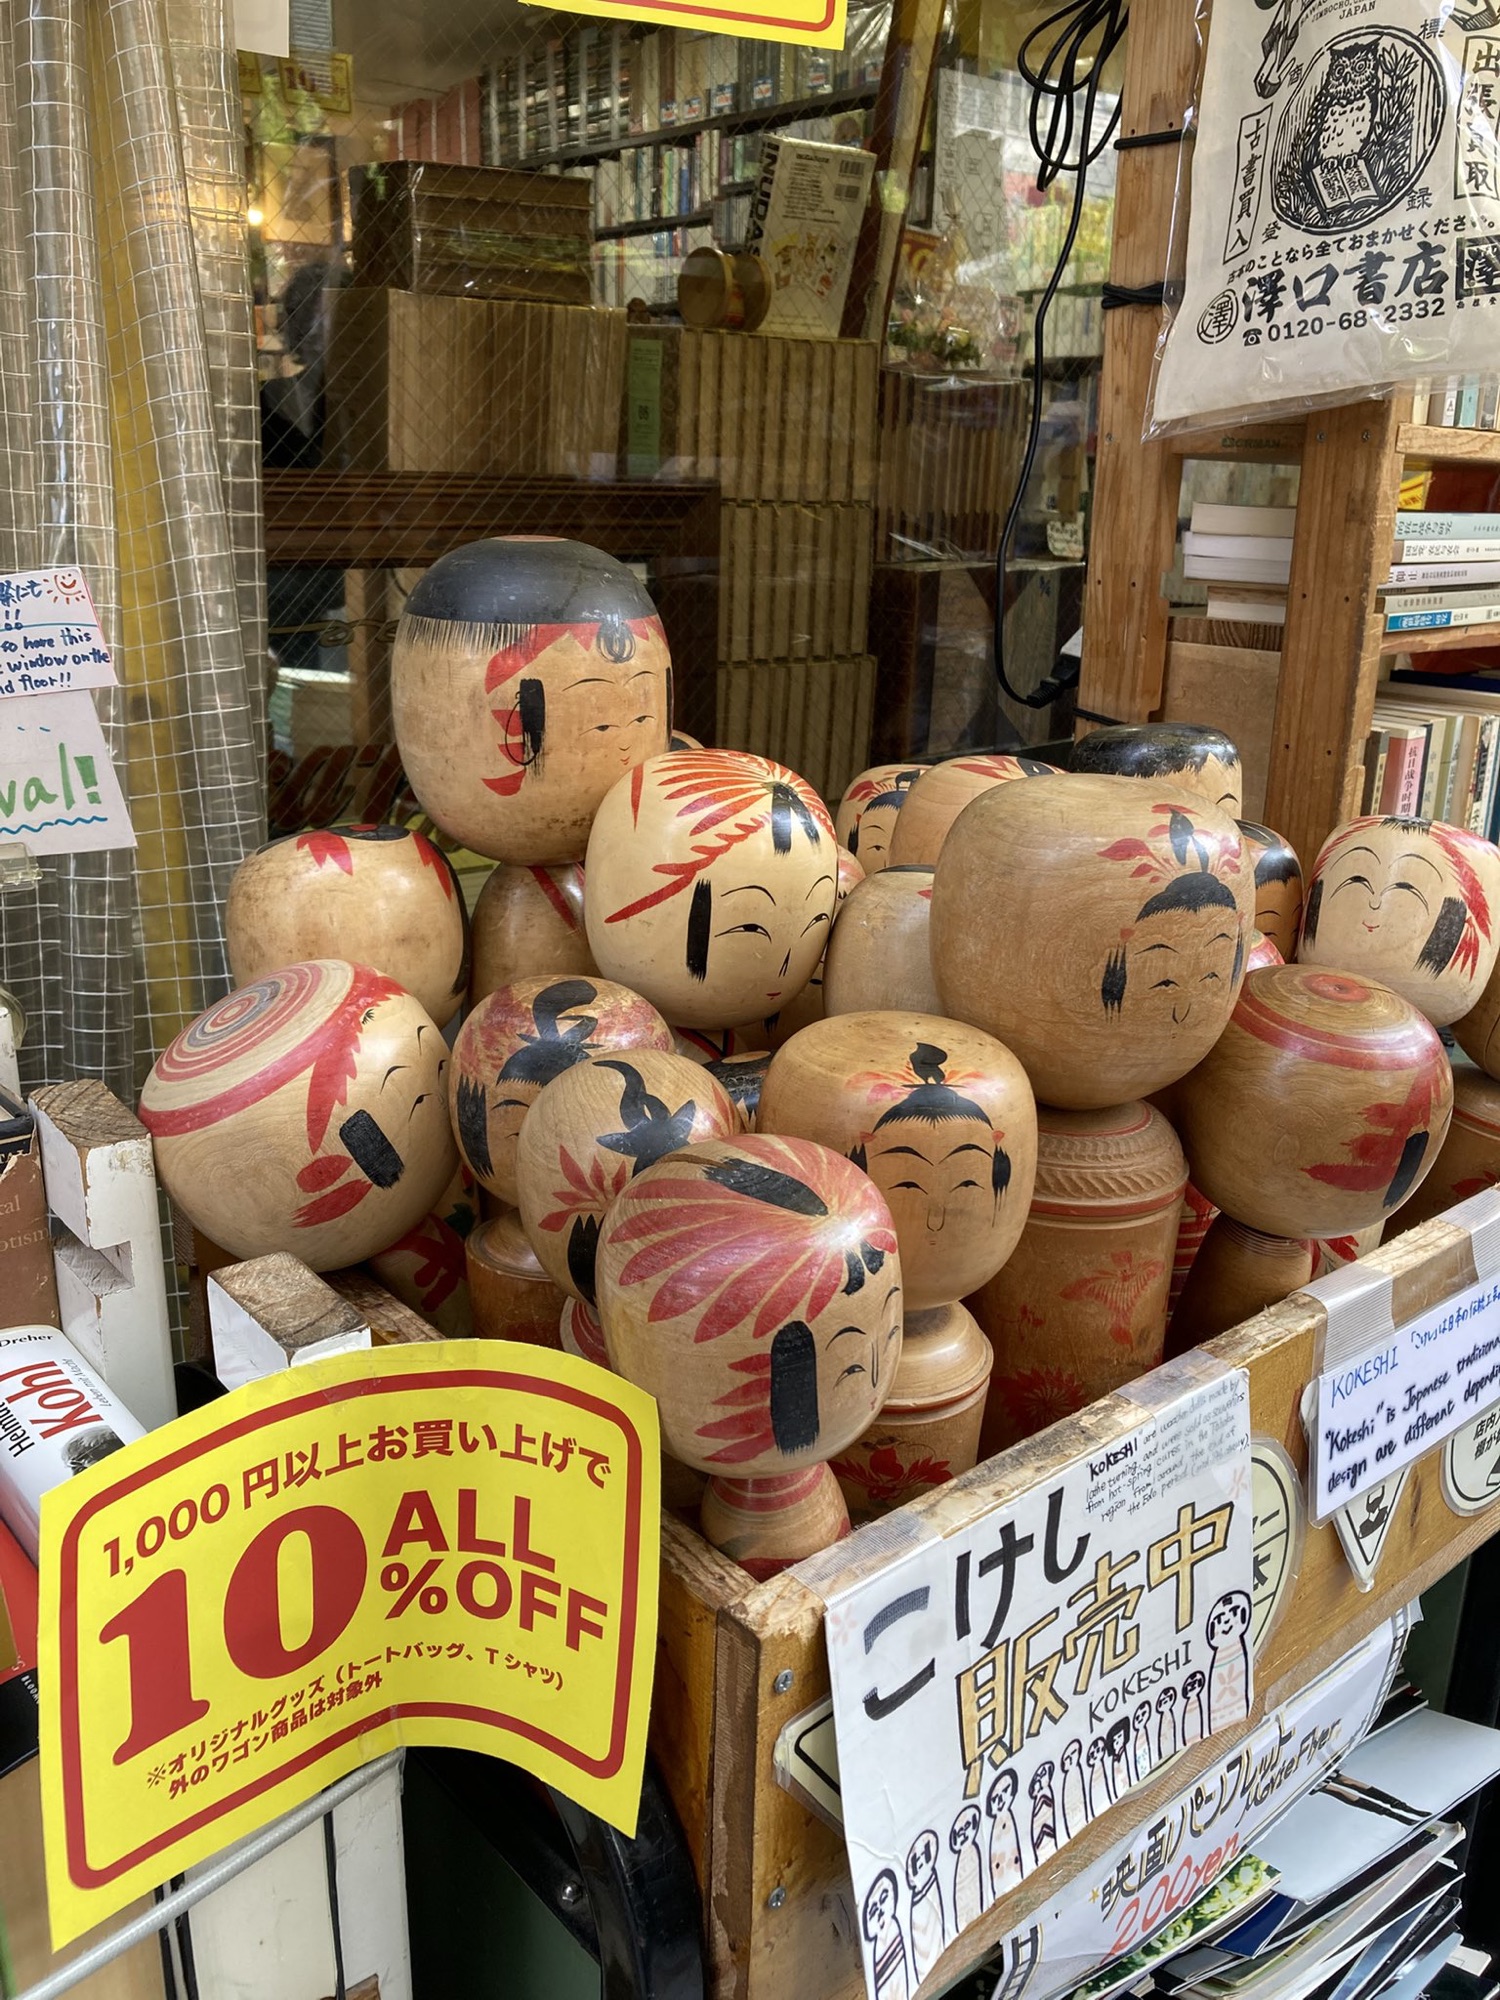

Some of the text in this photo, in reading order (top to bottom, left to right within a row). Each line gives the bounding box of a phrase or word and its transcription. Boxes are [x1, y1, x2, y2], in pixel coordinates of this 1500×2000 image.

[1339, 0, 1376, 20] JAPAN
[1229, 118, 1266, 253] 古書買入
[1406, 188, 1433, 211] 録
[1262, 220, 1281, 244] 登
[1242, 240, 1449, 323] 澤口書店
[6, 653, 68, 673] window
[60, 627, 92, 646] this
[1400, 746, 1419, 817] 抗日战争时期
[0, 1360, 104, 1440] Kohl
[1332, 1346, 1398, 1408] KOKESHI
[1386, 1407, 1396, 1424] is
[1402, 1371, 1450, 1412] Japanese
[1143, 1429, 1157, 1446] are
[1328, 1458, 1367, 1493] design
[1375, 1439, 1397, 1462] are
[1404, 1400, 1456, 1446] different
[1473, 1408, 1500, 1441] 店内
[103, 1419, 613, 1577] 1,000 円以上お買い上げで
[381, 1489, 556, 1574] ALL
[1085, 1496, 1105, 1514] from
[99, 1504, 368, 1766] 10
[379, 1557, 608, 1653] %OFF
[863, 1486, 1091, 1721] こけし
[20, 1674, 39, 1705] BLOOM
[955, 1500, 1234, 1800] 販売中
[1089, 1640, 1194, 1732] KOKESHI
[168, 1671, 384, 1801] 外のワゴン商品は対象外
[1101, 1713, 1296, 1922] 映画パンフレット
